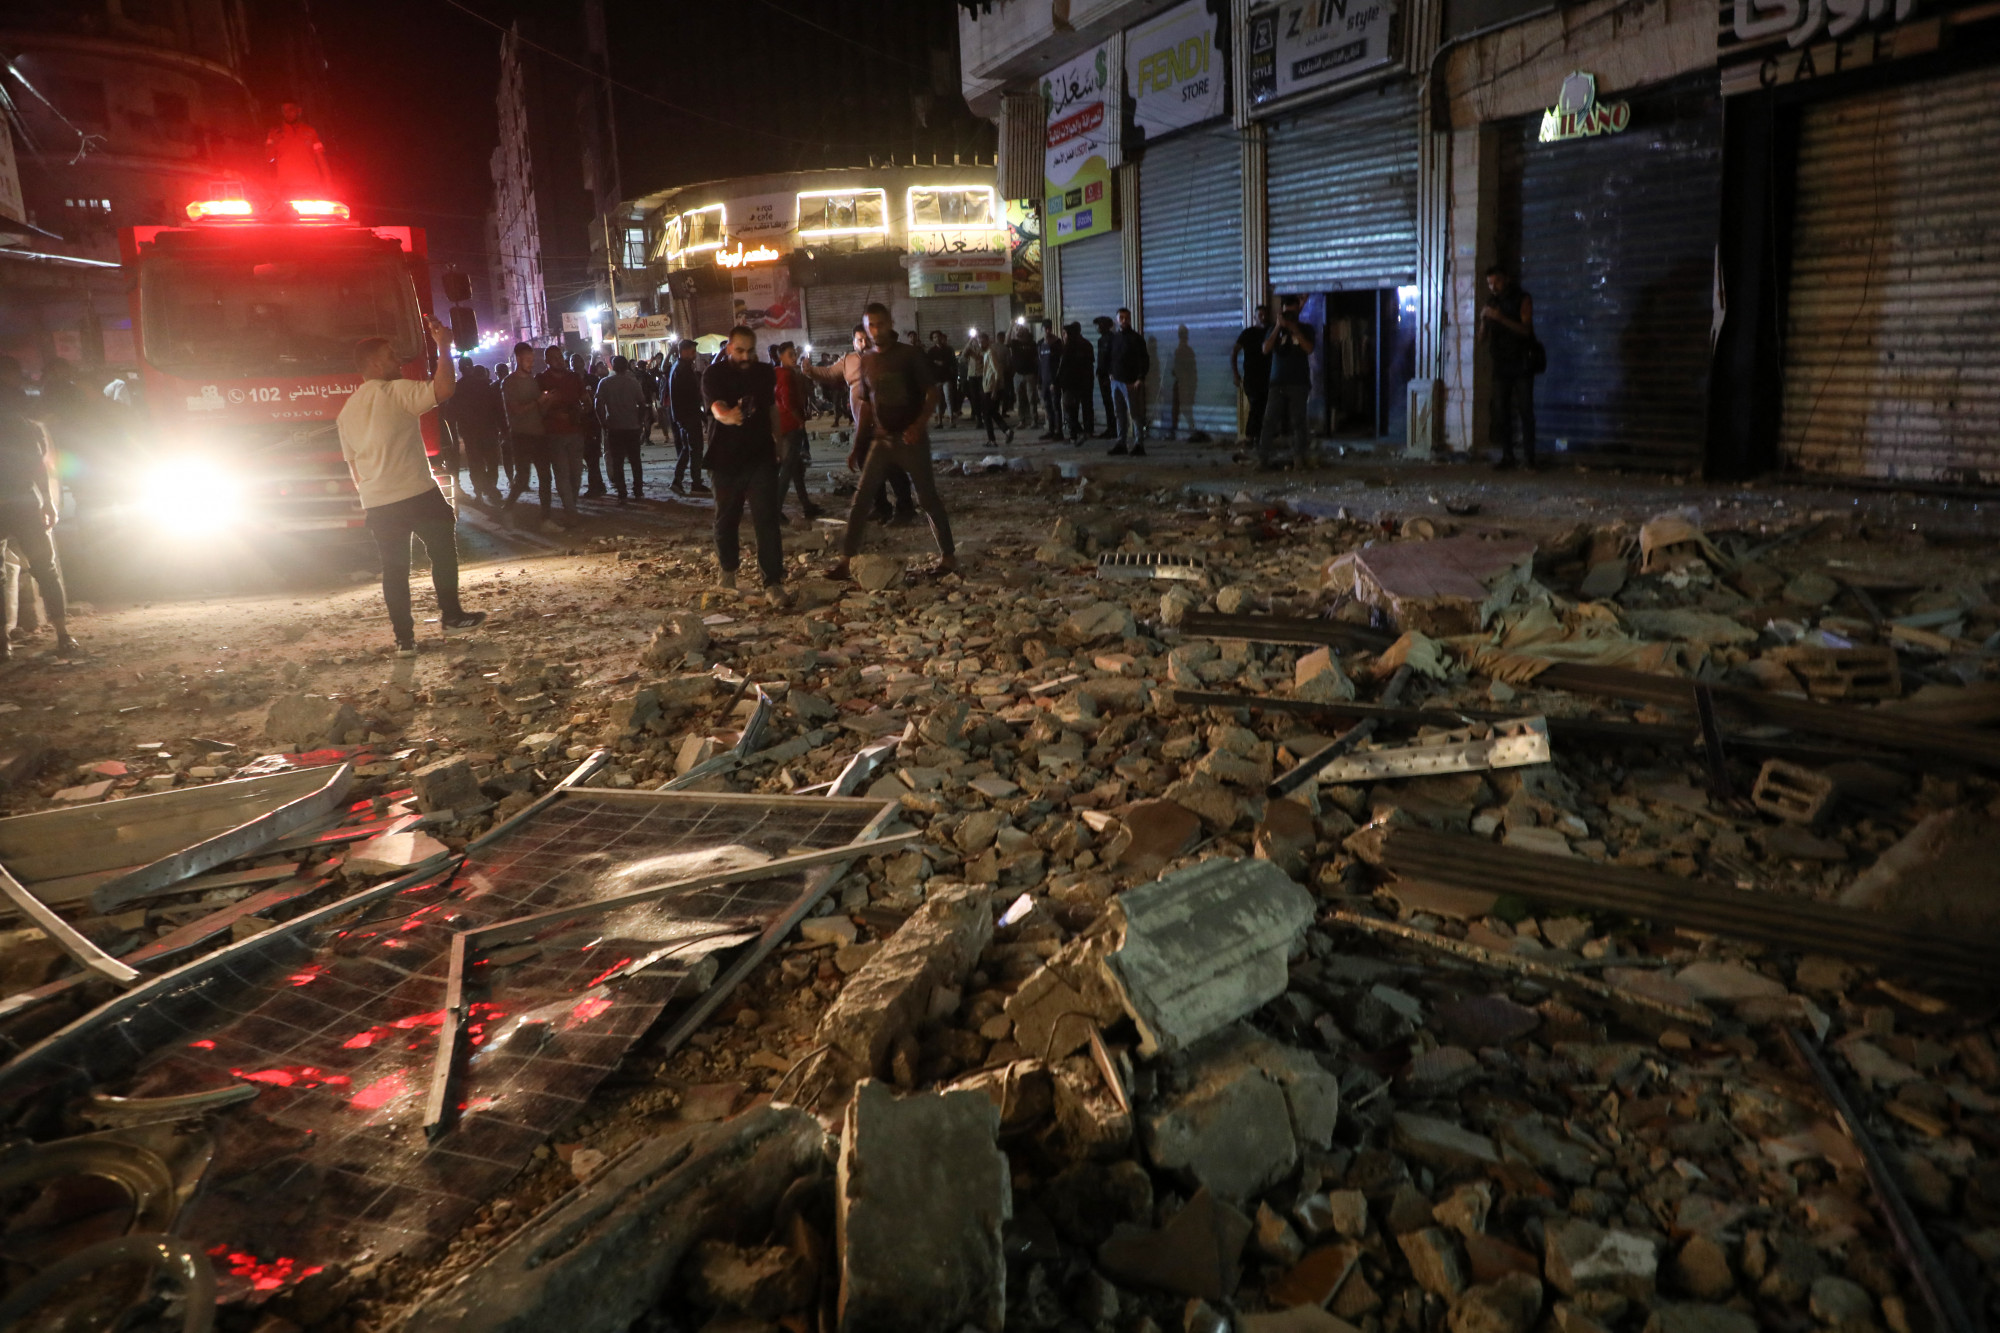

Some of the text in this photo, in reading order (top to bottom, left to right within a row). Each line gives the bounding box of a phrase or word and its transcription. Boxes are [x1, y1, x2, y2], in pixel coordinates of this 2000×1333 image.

[1346, 5, 1381, 33] style
[1138, 28, 1211, 99] FENDI
[1252, 63, 1273, 80] STYLE
[1759, 33, 1895, 89] CAFE
[1182, 78, 1210, 103] STORE
[1538, 93, 1631, 144] MILANO
[249, 383, 357, 403] الدفاع المدني 102
[271, 409, 324, 419] VOLVO
